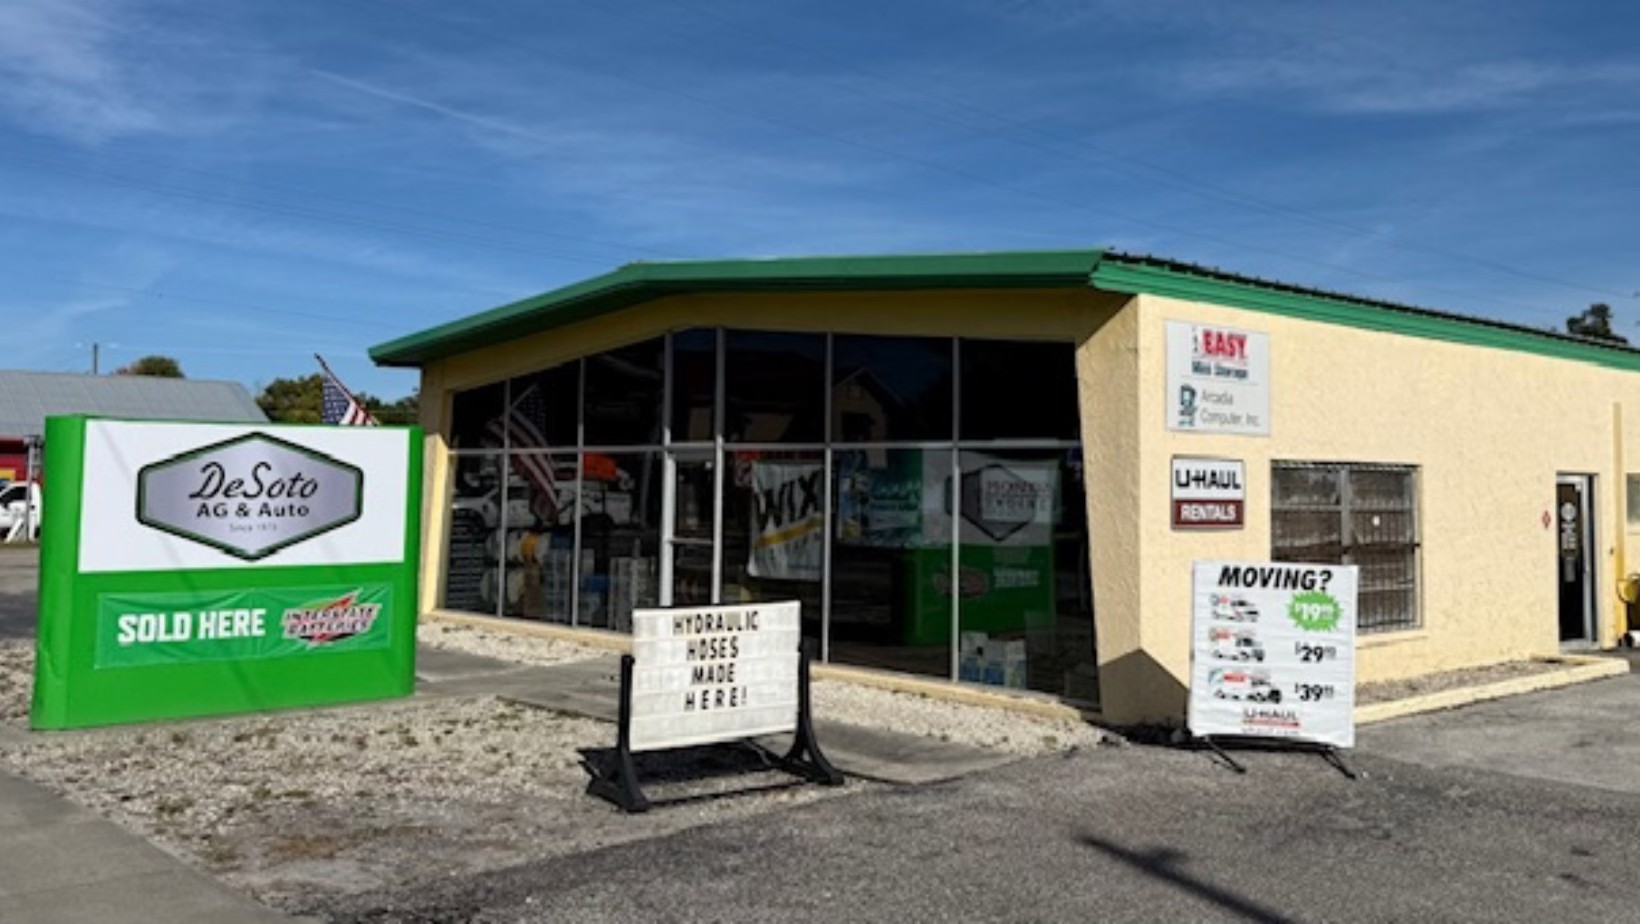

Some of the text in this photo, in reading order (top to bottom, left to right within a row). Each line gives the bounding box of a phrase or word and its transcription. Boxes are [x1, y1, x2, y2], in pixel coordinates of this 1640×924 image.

[1202, 329, 1248, 360] EASY
[1201, 389, 1233, 407] Arcadia
[188, 461, 319, 500] DeSoto
[197, 502, 310, 518] AG & Auto
[753, 470, 821, 531] WIX
[1180, 504, 1236, 521] RENTALS
[1218, 565, 1333, 592] MOVING?
[117, 608, 267, 646] SOLD HERE
[672, 611, 759, 635] HYDRAULIC
[686, 636, 740, 661] HOSES
[691, 663, 734, 685] MADE
[684, 687, 747, 712] HERE!
